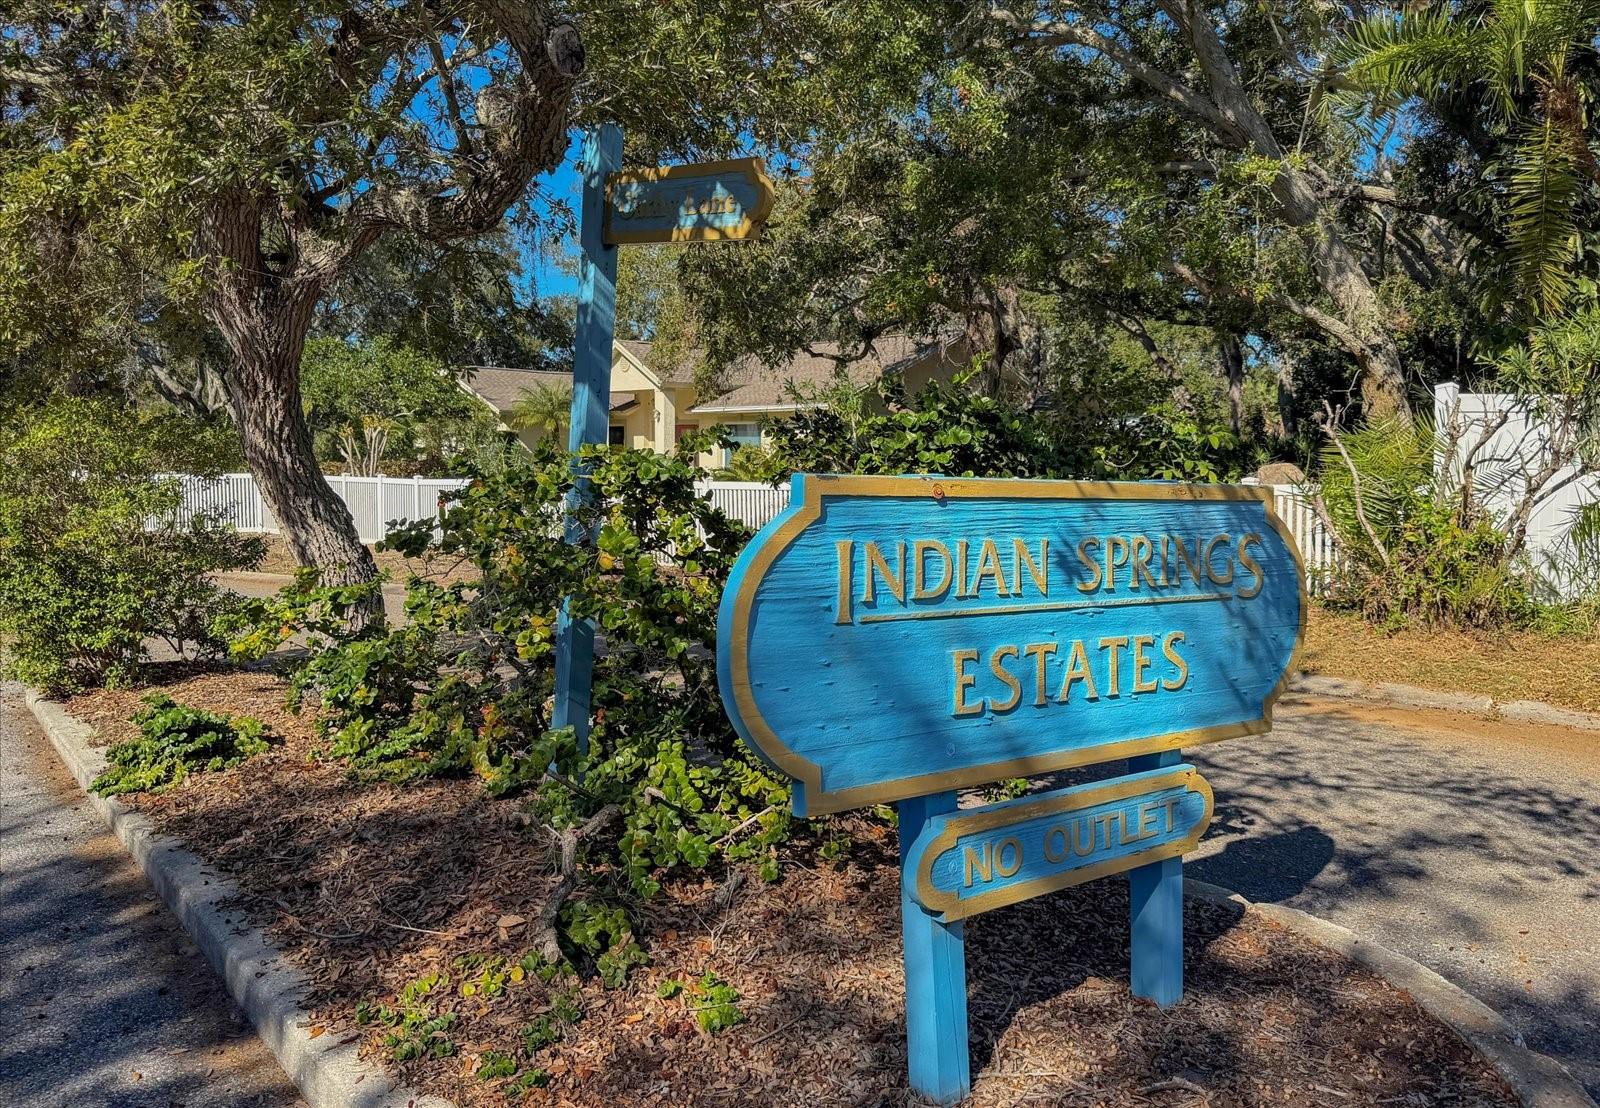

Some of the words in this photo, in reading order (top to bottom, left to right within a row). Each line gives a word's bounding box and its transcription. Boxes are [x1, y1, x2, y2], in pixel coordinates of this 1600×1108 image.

[684, 191, 737, 215] Lane
[834, 538, 1049, 625] INDIAN
[1076, 533, 1265, 598] SPRINGS
[951, 631, 1190, 717] ESTATES
[963, 837, 1023, 887] NO
[1043, 798, 1180, 864] OUTLET
